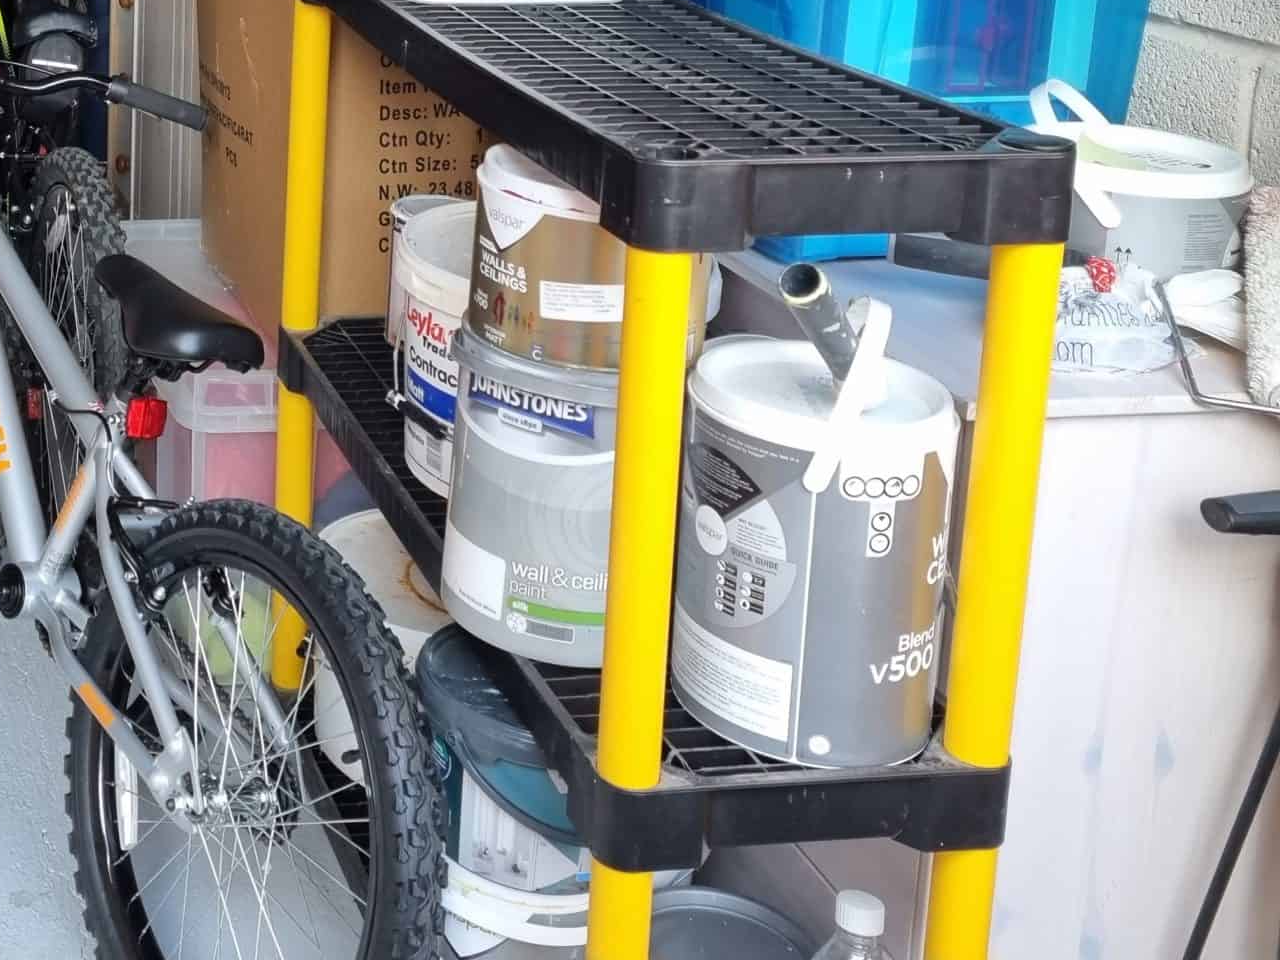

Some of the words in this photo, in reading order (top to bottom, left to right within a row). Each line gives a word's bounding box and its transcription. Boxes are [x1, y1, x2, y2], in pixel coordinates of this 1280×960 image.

[380, 79, 417, 95] Item
[379, 104, 428, 121] Desc:
[379, 131, 408, 147] Ctn
[415, 130, 451, 149] Qty:
[379, 158, 408, 174] Ctn
[415, 156, 457, 172] Size:
[428, 181, 474, 196] 23.48
[488, 206, 527, 231] valspar
[481, 249, 515, 275] WALLS
[516, 265, 527, 280] &
[479, 261, 528, 294] CEILINGS
[409, 345, 459, 388] Contrac
[511, 560, 549, 584] wall
[551, 568, 569, 588] &
[571, 572, 608, 591] ceili
[509, 581, 548, 601] paint
[898, 622, 936, 653] Blend
[869, 642, 934, 685] v500
